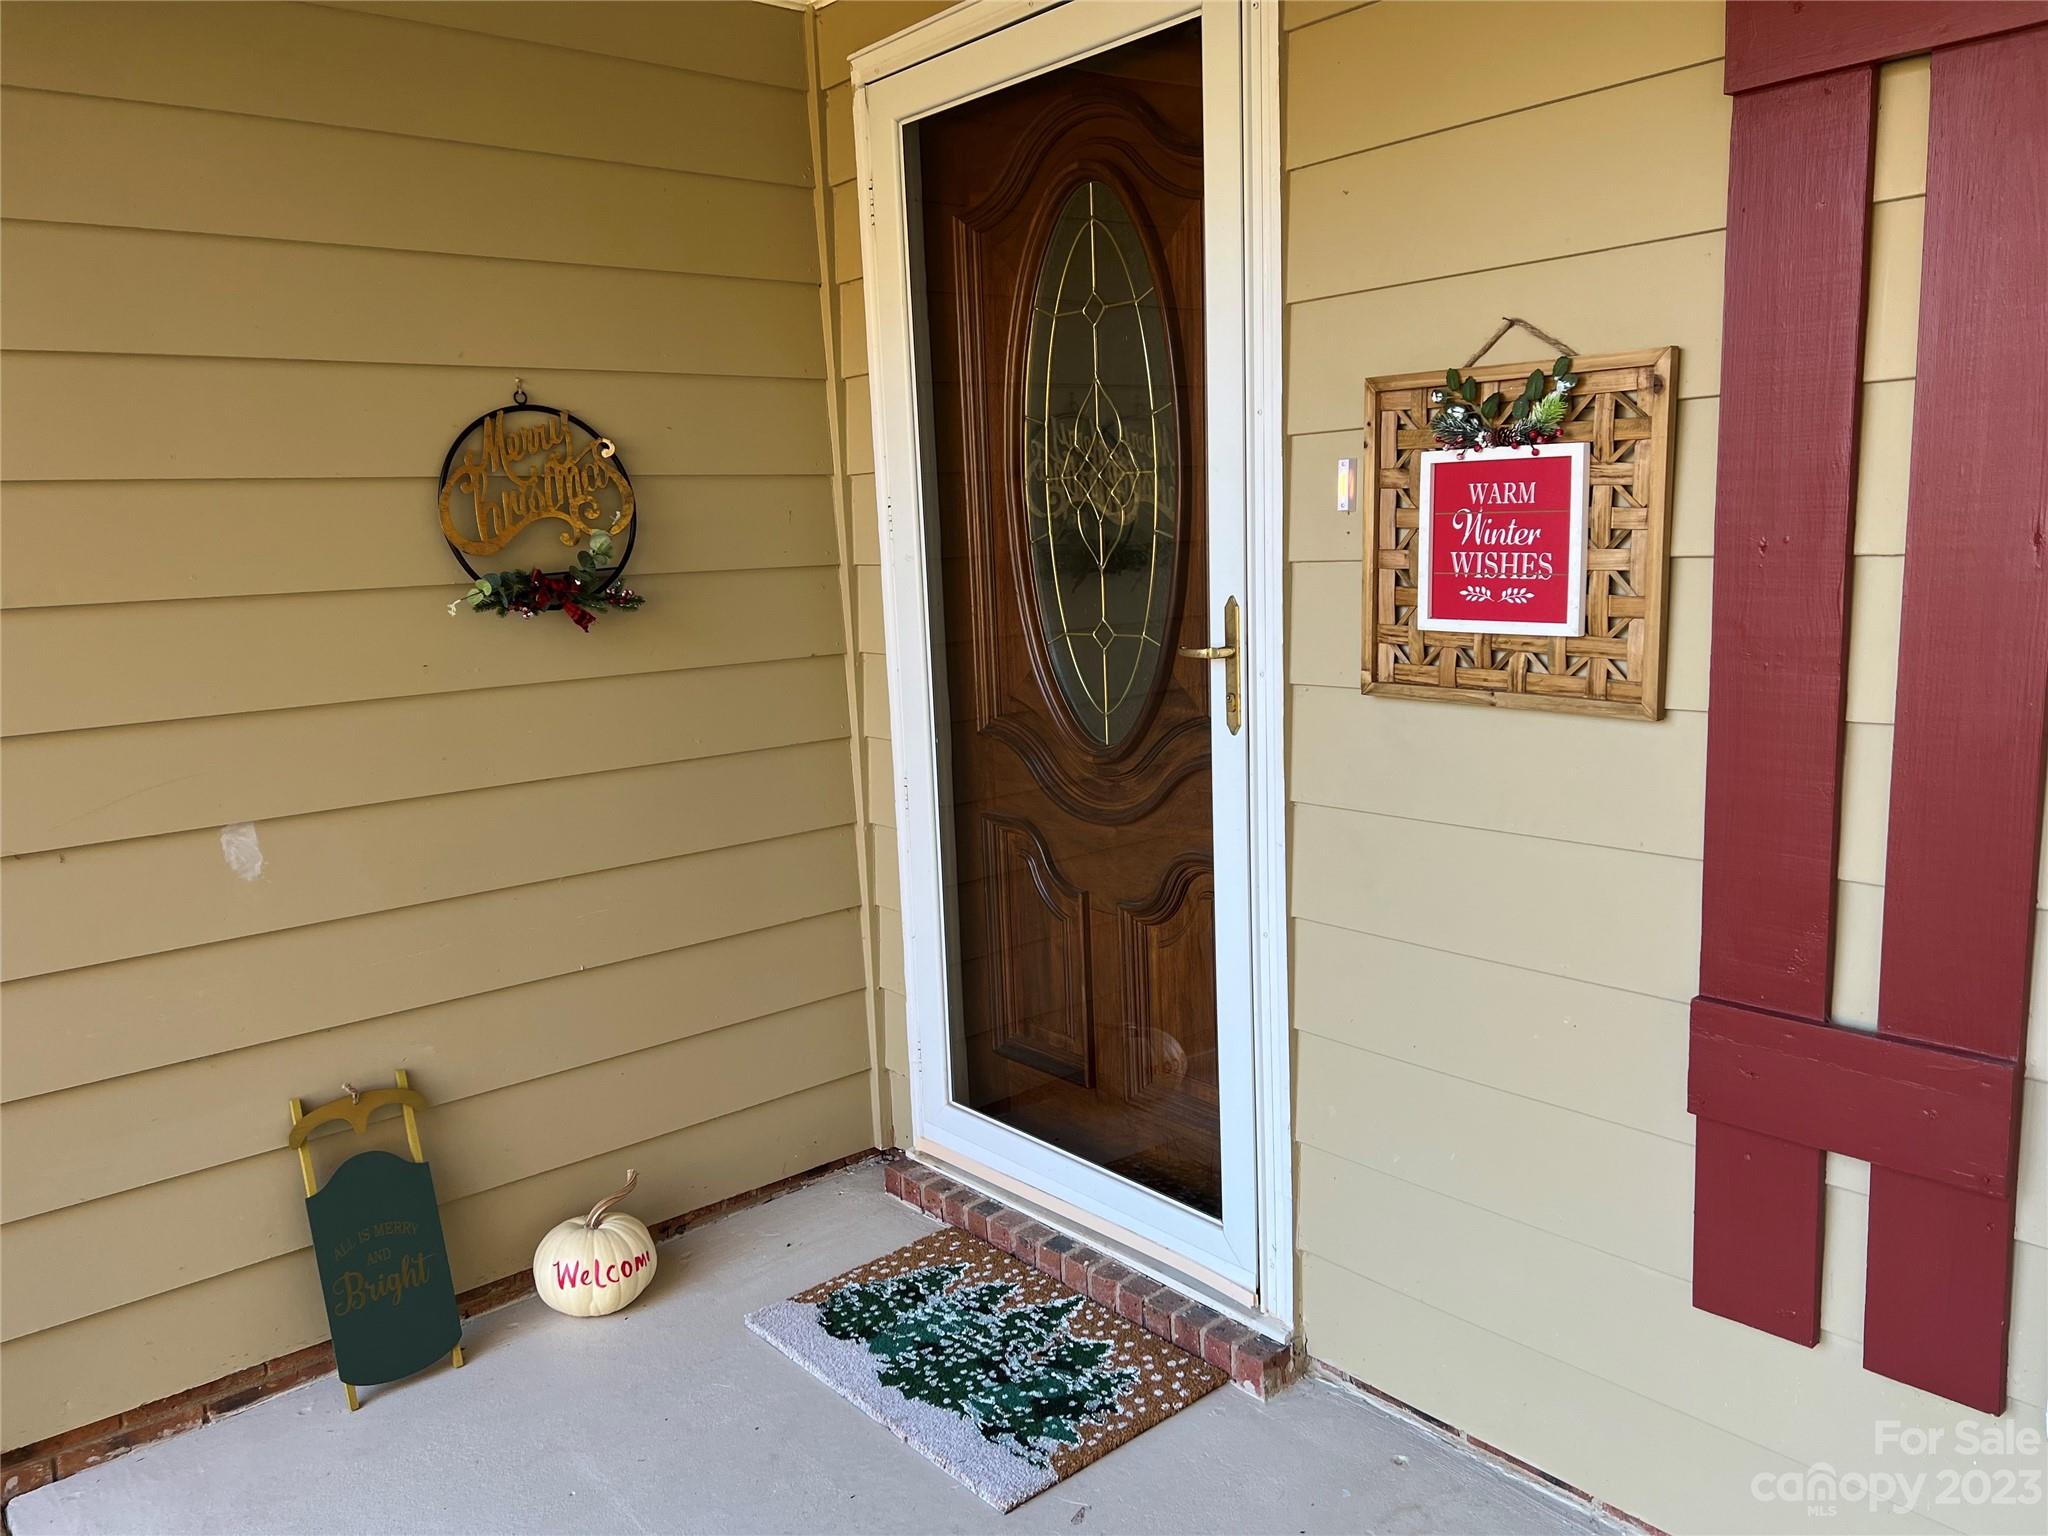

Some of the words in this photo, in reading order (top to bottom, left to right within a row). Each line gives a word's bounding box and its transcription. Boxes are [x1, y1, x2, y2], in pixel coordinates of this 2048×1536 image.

[464, 410, 574, 476] Merry
[440, 437, 634, 556] Christmas
[1468, 481, 1537, 505] WARM
[1452, 506, 1542, 546] Winter
[1450, 551, 1553, 581] WISHES
[335, 1237, 357, 1262] ALL
[358, 1228, 370, 1244] IS
[373, 1220, 419, 1238] MERRY
[367, 1247, 392, 1266] AND
[332, 1252, 434, 1316] Bright
